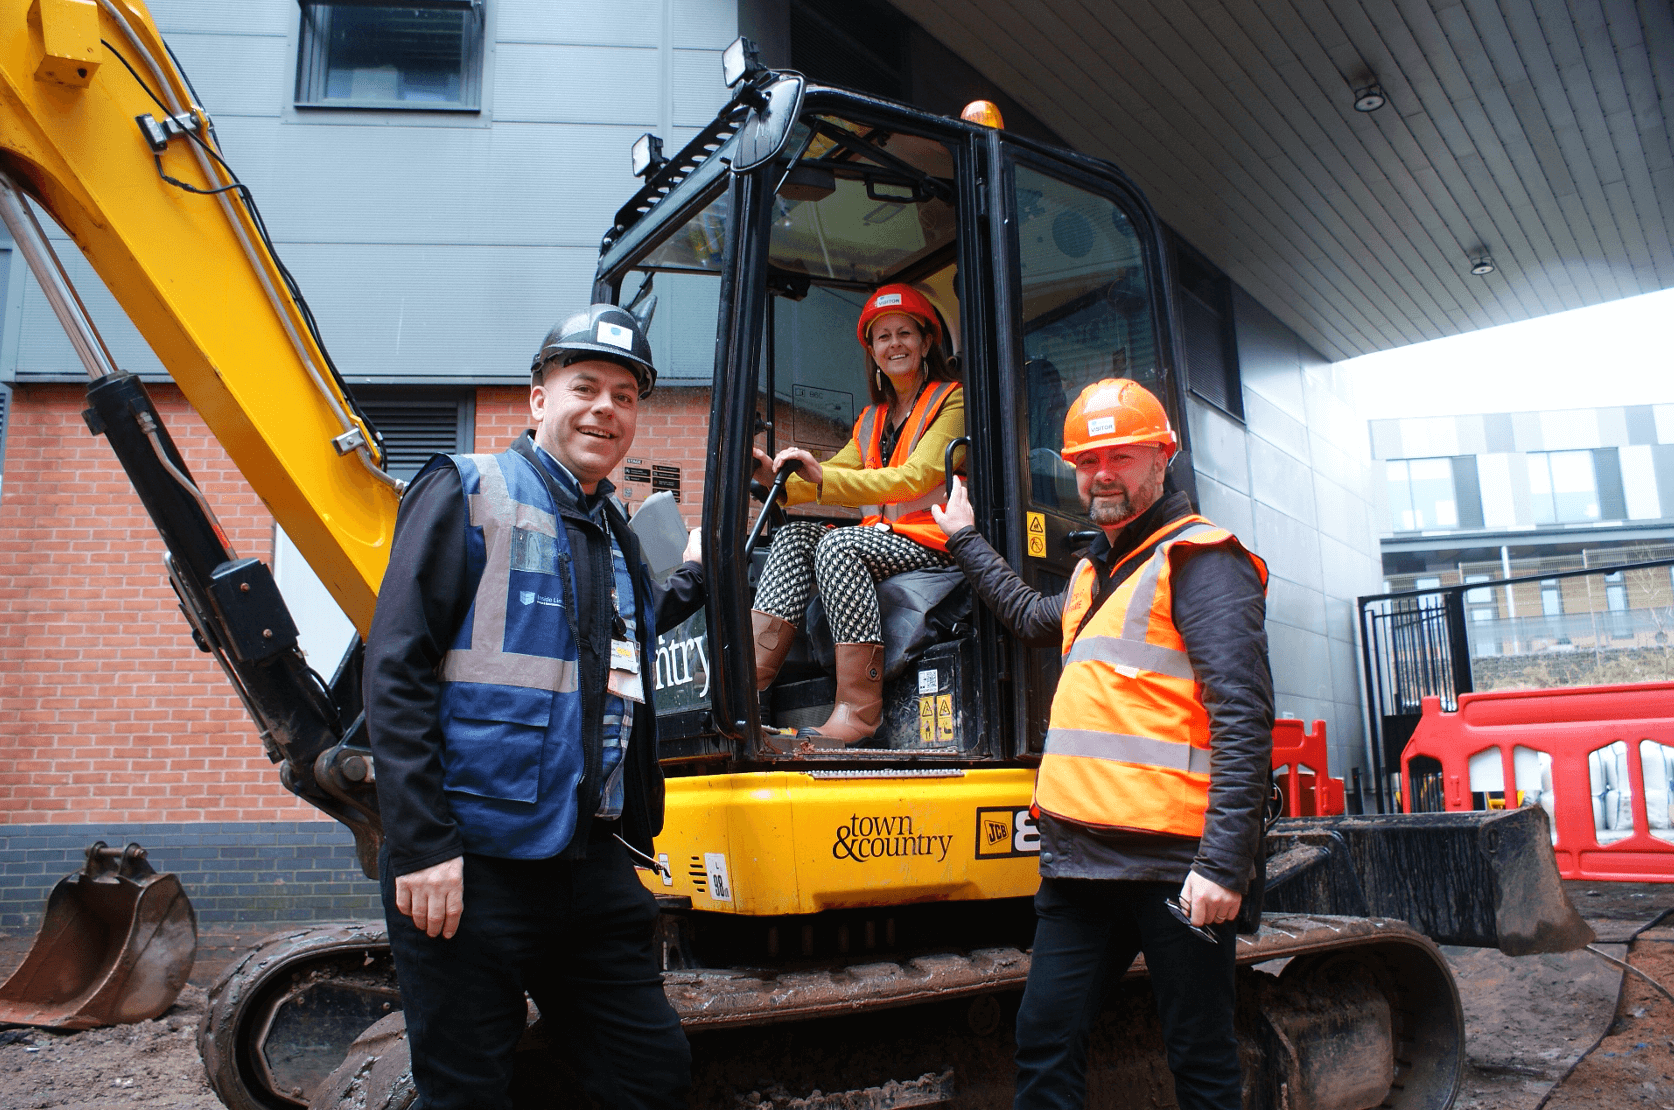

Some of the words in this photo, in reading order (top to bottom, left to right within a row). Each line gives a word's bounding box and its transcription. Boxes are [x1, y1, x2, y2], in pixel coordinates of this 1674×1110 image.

[1091, 425, 1113, 433] VISITOR
[850, 813, 913, 837] town
[988, 822, 1007, 843] JCB
[713, 874, 724, 897] 98
